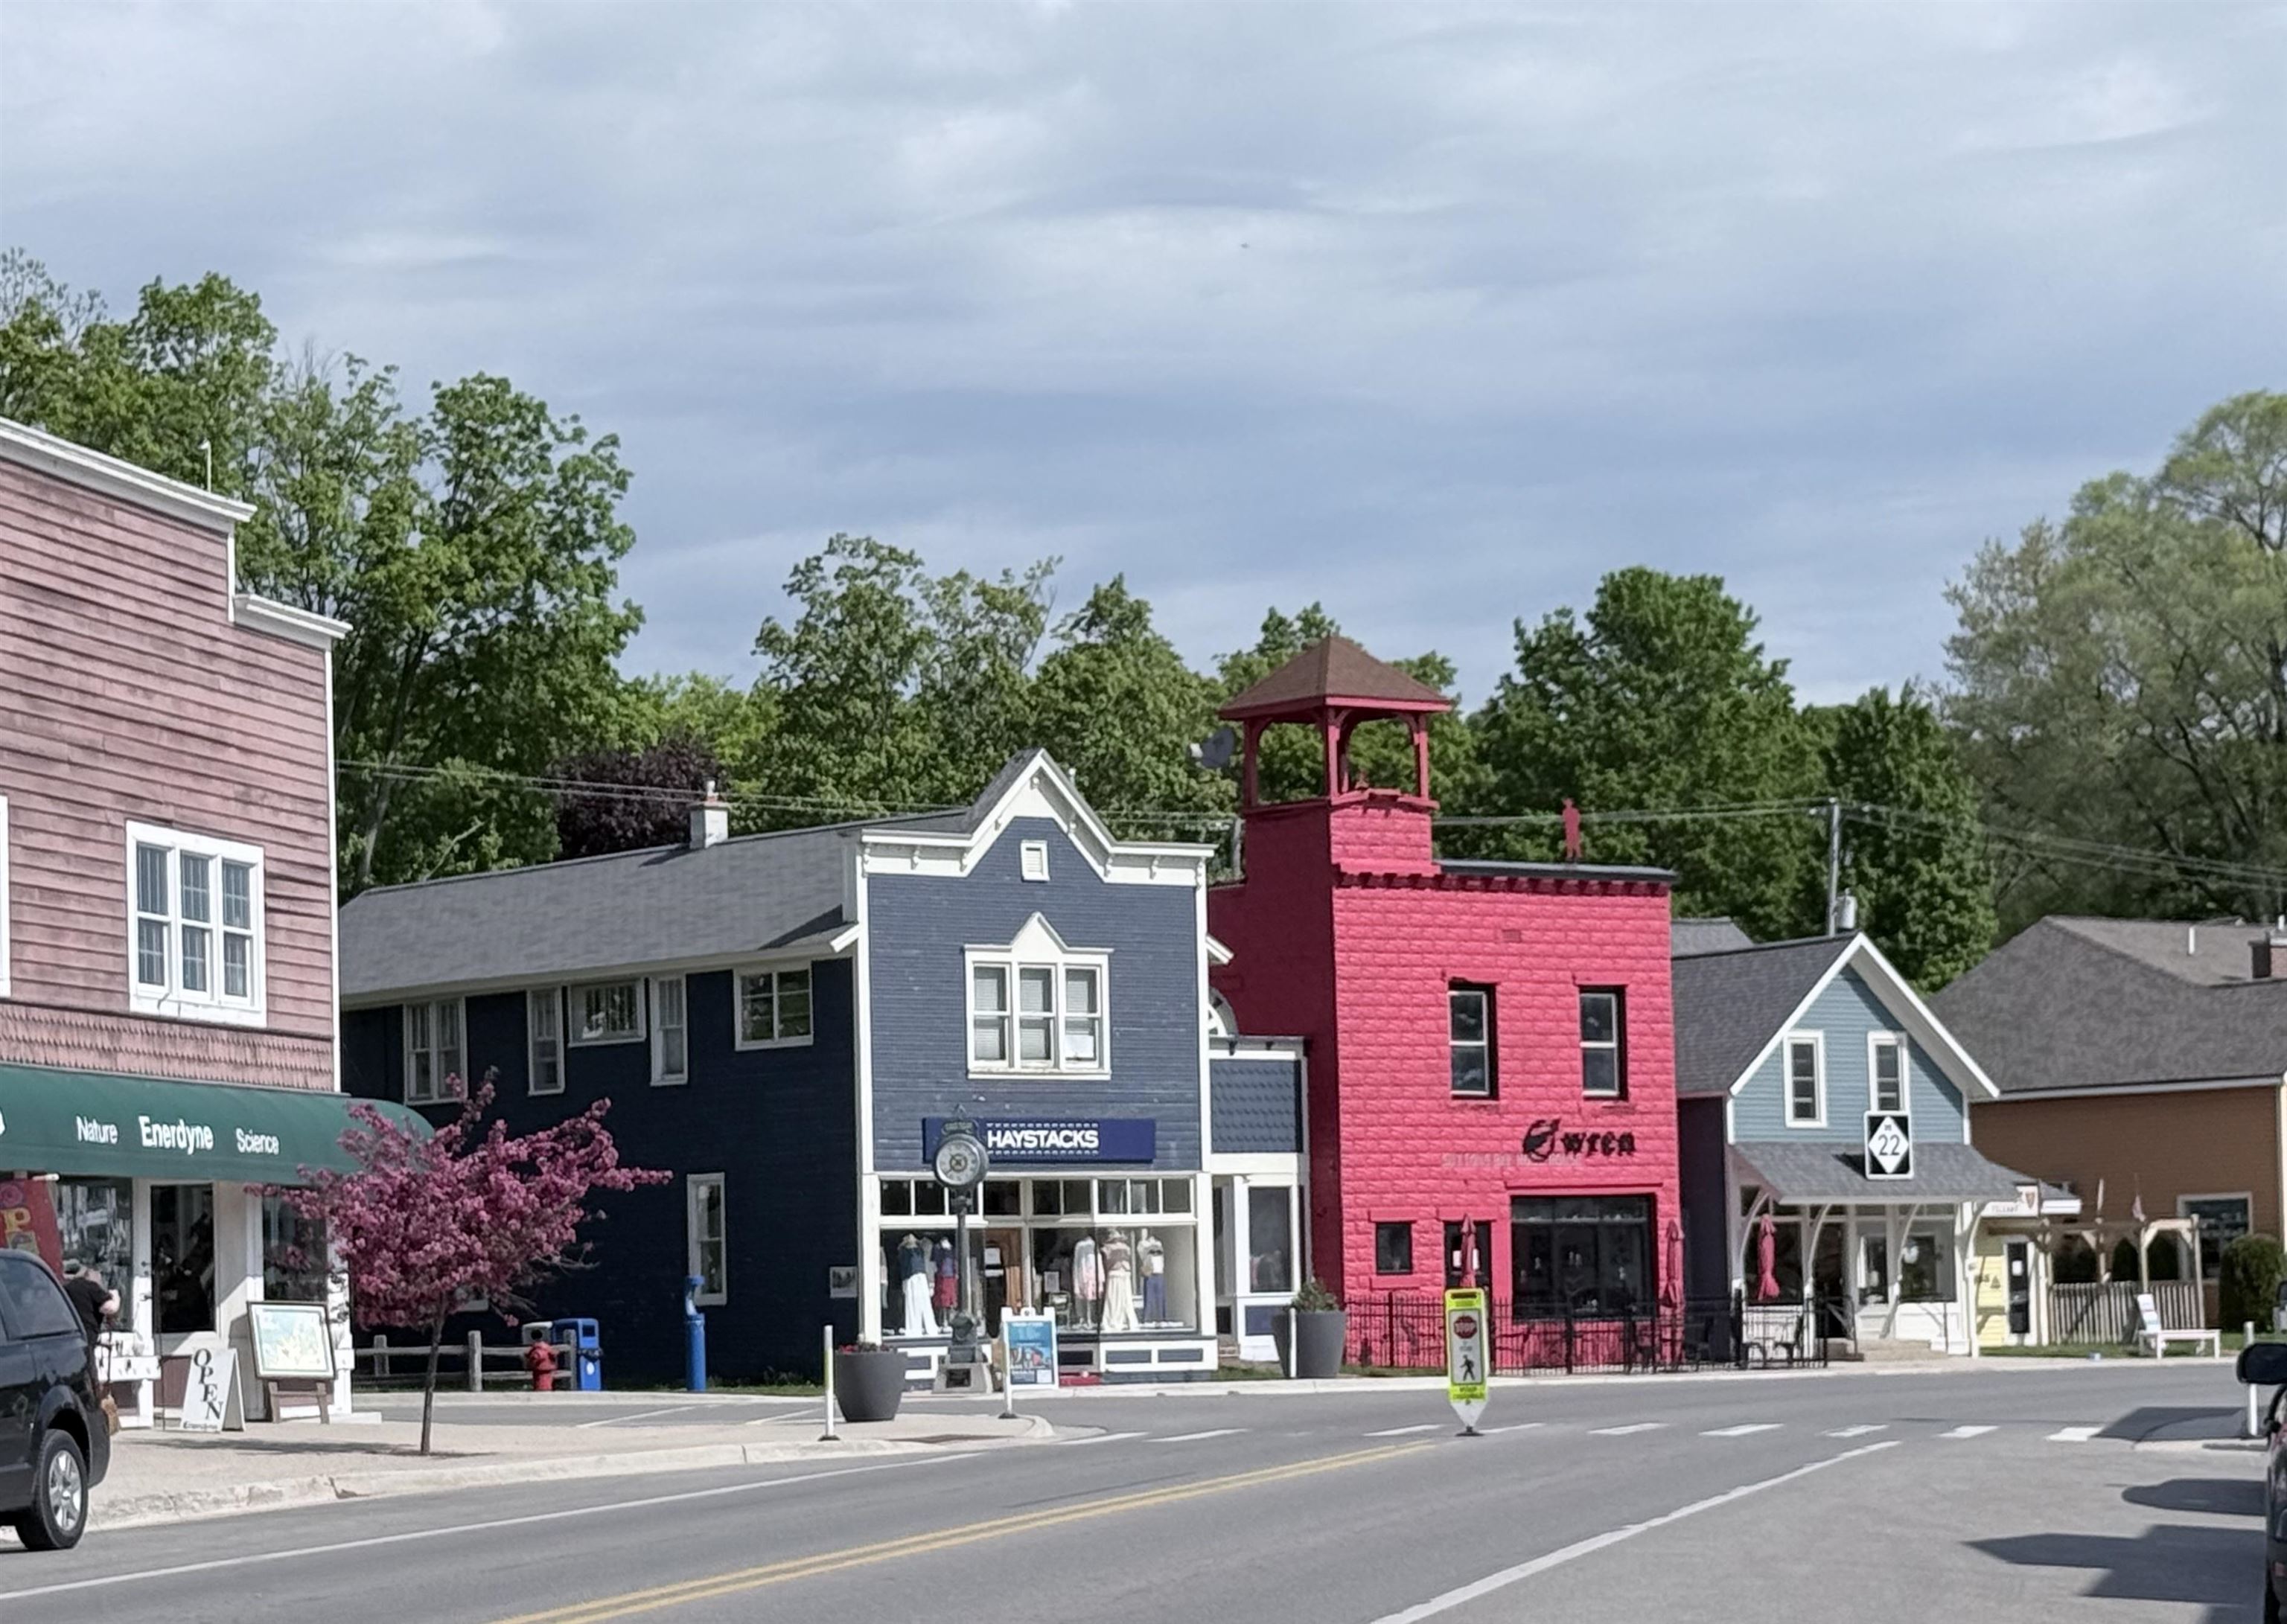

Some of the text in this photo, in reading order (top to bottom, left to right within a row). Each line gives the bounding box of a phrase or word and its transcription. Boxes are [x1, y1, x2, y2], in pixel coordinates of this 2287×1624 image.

[76, 1116, 118, 1144] Nature
[138, 1116, 214, 1154] Enerdyne
[235, 1128, 279, 1154] Science
[987, 1130, 1099, 1148] HAYSTACKS
[1560, 1131, 1636, 1157] wren
[1878, 1134, 1900, 1156] 22
[194, 1348, 224, 1419] OPEN
